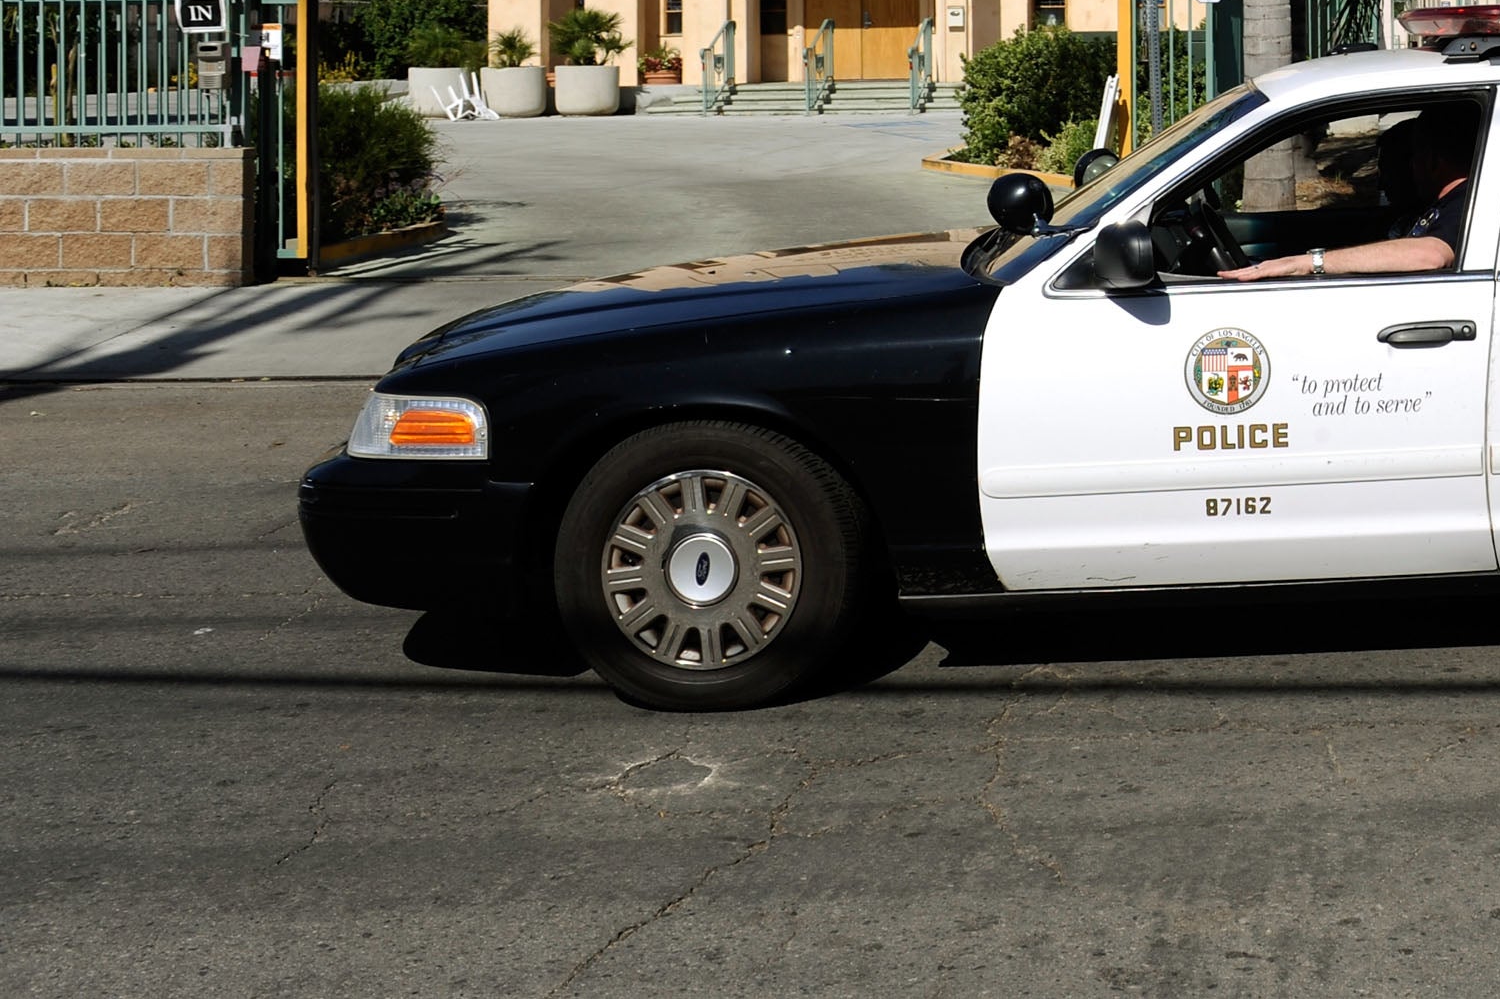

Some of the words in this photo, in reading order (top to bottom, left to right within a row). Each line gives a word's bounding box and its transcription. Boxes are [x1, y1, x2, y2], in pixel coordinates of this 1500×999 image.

[188, 5, 212, 21] IN
[1191, 340, 1207, 357] CITY
[1206, 333, 1214, 342] OF
[1218, 329, 1233, 337] LOS
[1235, 331, 1264, 356] ANGELES
[1323, 372, 1383, 397] protect
[1203, 399, 1235, 412] FOUNDED
[1312, 394, 1348, 417] and
[1354, 396, 1371, 415] to
[1172, 422, 1289, 451] POLICE
[1205, 496, 1272, 517] 87162
